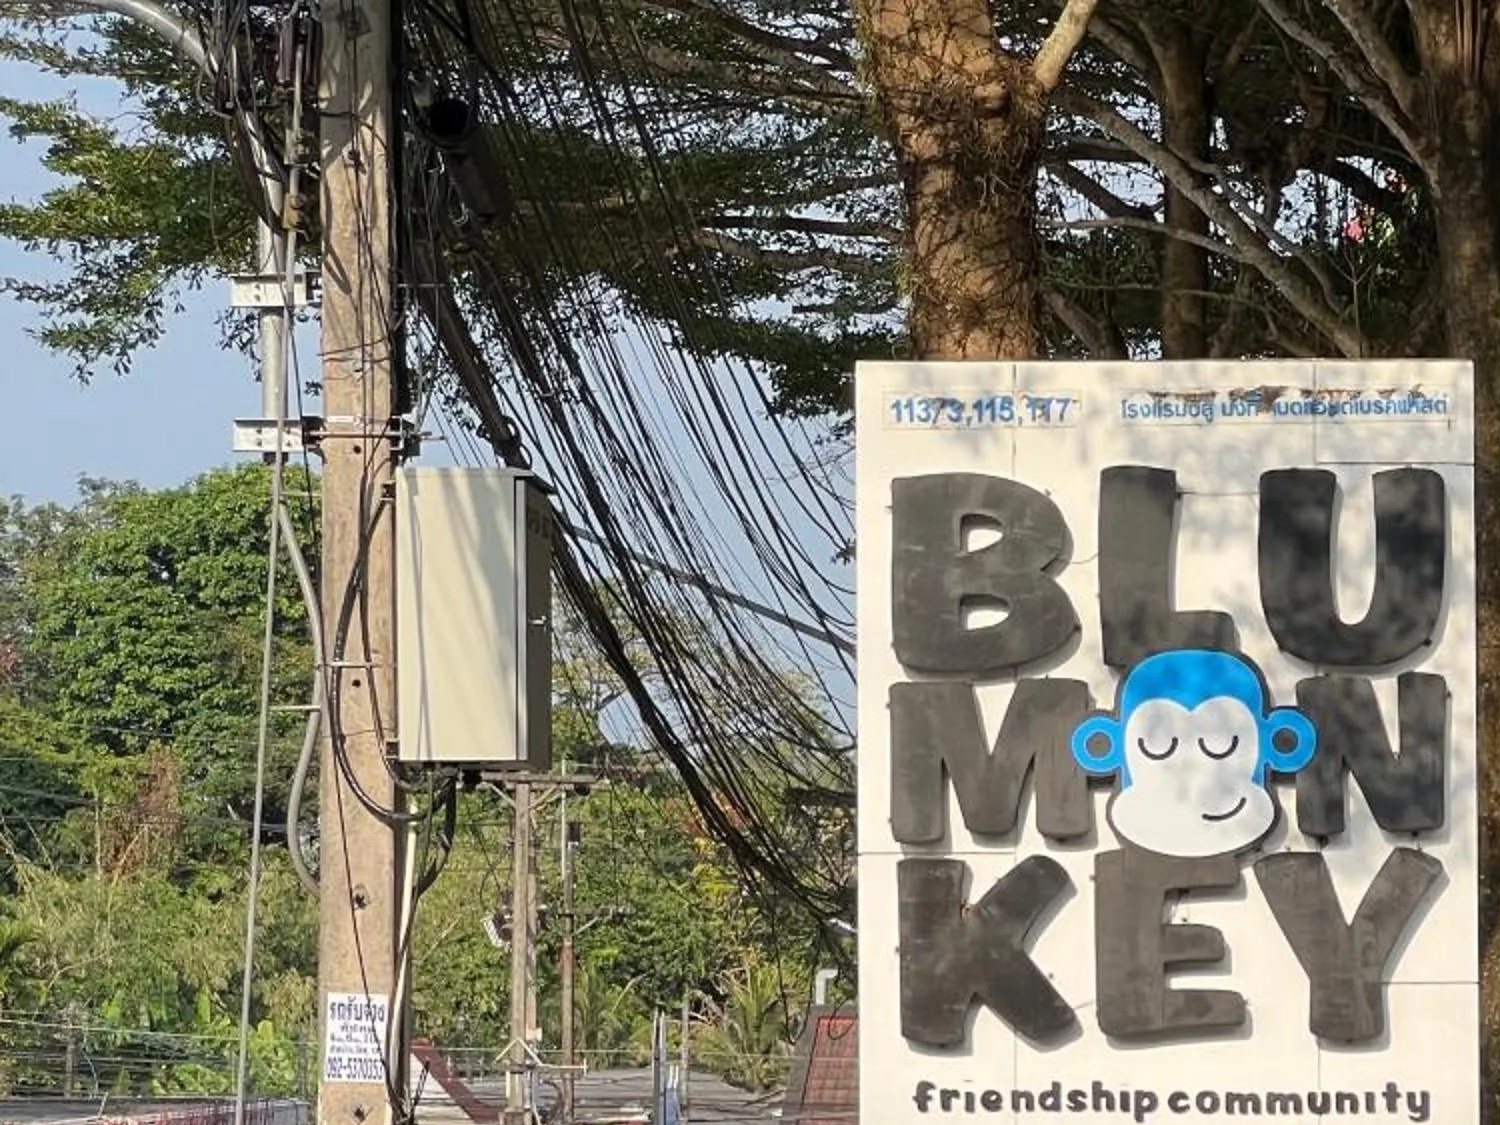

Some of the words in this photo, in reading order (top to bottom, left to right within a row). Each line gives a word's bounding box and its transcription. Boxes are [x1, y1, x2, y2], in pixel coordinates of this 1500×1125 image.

[891, 465, 1446, 674] BLU
[889, 672, 1447, 845] MN
[897, 847, 1449, 1049] KEY
[913, 1081, 1158, 1122] friendship
[1168, 1082, 1430, 1121] community
